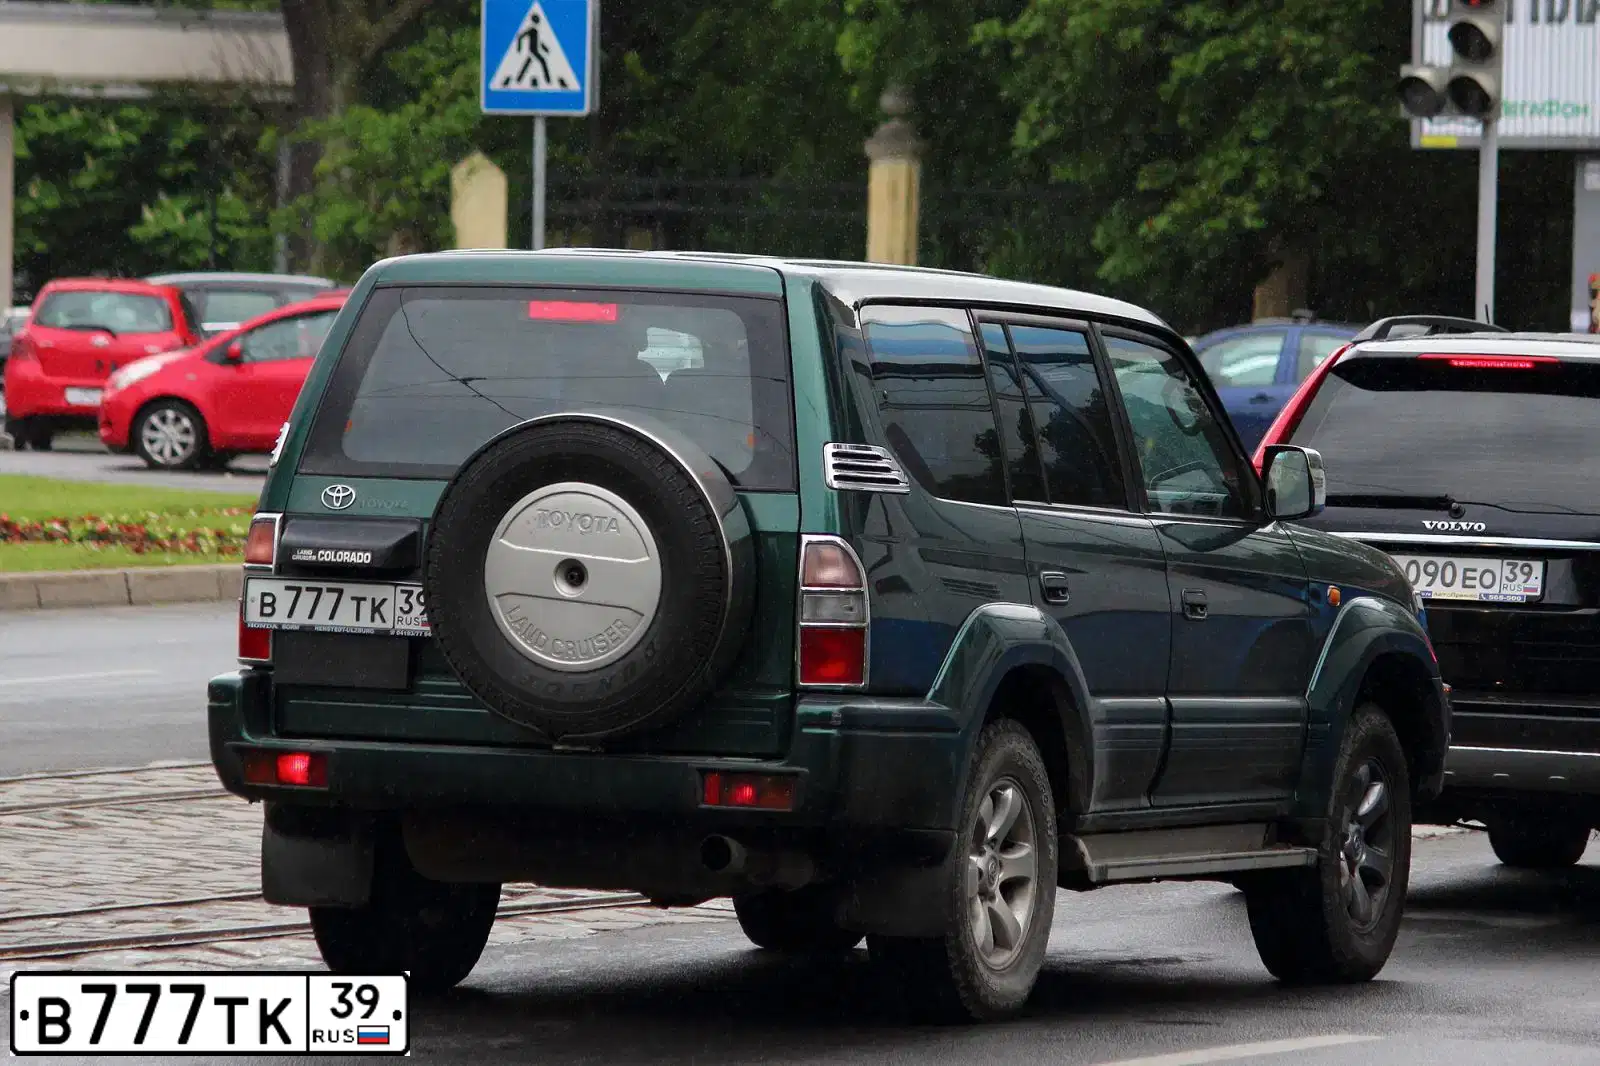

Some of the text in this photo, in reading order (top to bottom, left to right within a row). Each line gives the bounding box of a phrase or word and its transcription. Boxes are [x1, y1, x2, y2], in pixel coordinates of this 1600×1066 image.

[1501, 100, 1590, 117] егаФон
[537, 508, 622, 536] TOYOTA
[1422, 520, 1486, 532] VOLVO
[296, 549, 313, 557] LAND
[317, 550, 372, 564] COLORADO
[1404, 559, 1534, 590] 090ЕО 39
[1502, 583, 1523, 592] RUS
[247, 622, 279, 630] HONDA
[396, 616, 419, 627] RUS
[505, 604, 631, 659] LAND CRUISER
